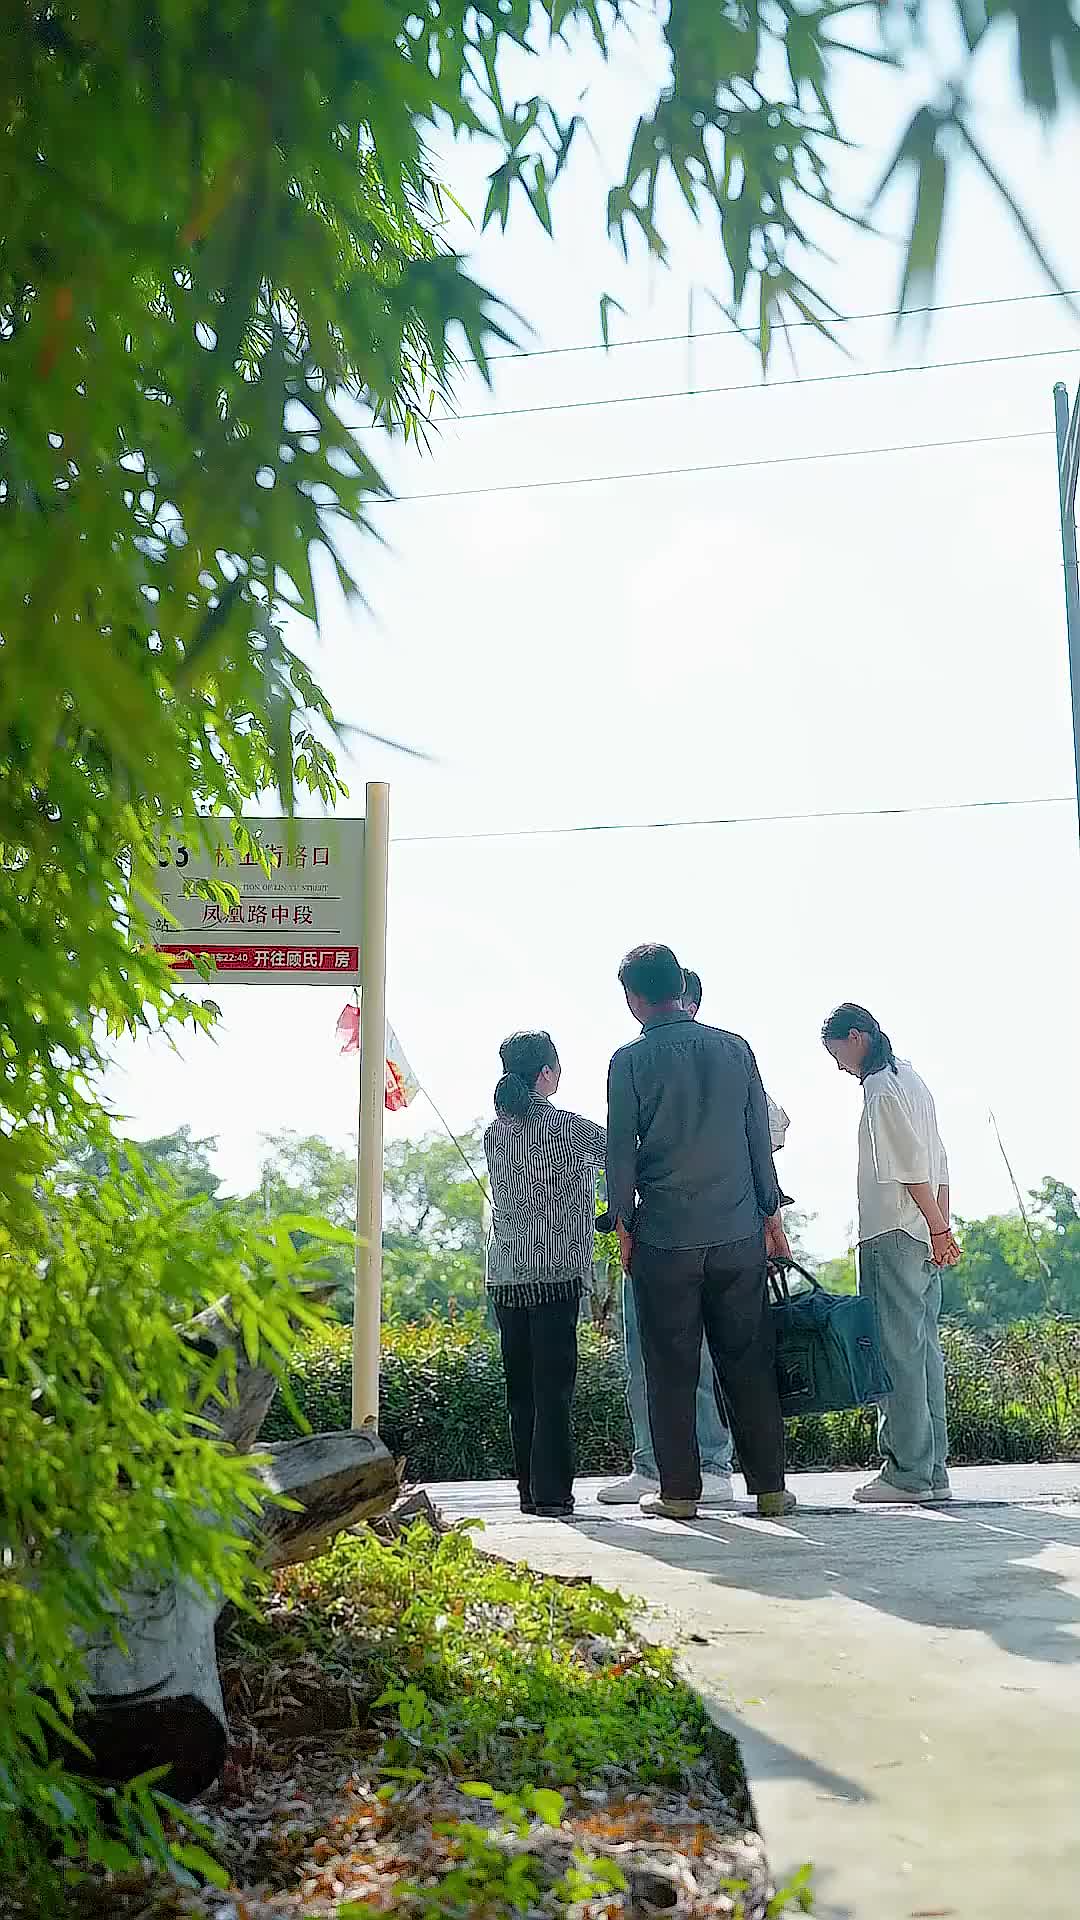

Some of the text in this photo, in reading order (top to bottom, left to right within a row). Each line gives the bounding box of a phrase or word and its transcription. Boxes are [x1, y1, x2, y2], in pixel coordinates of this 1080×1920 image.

[202, 904, 313, 925] 凤凰路中段
[254, 950, 351, 968] 开往顾氏厂房
